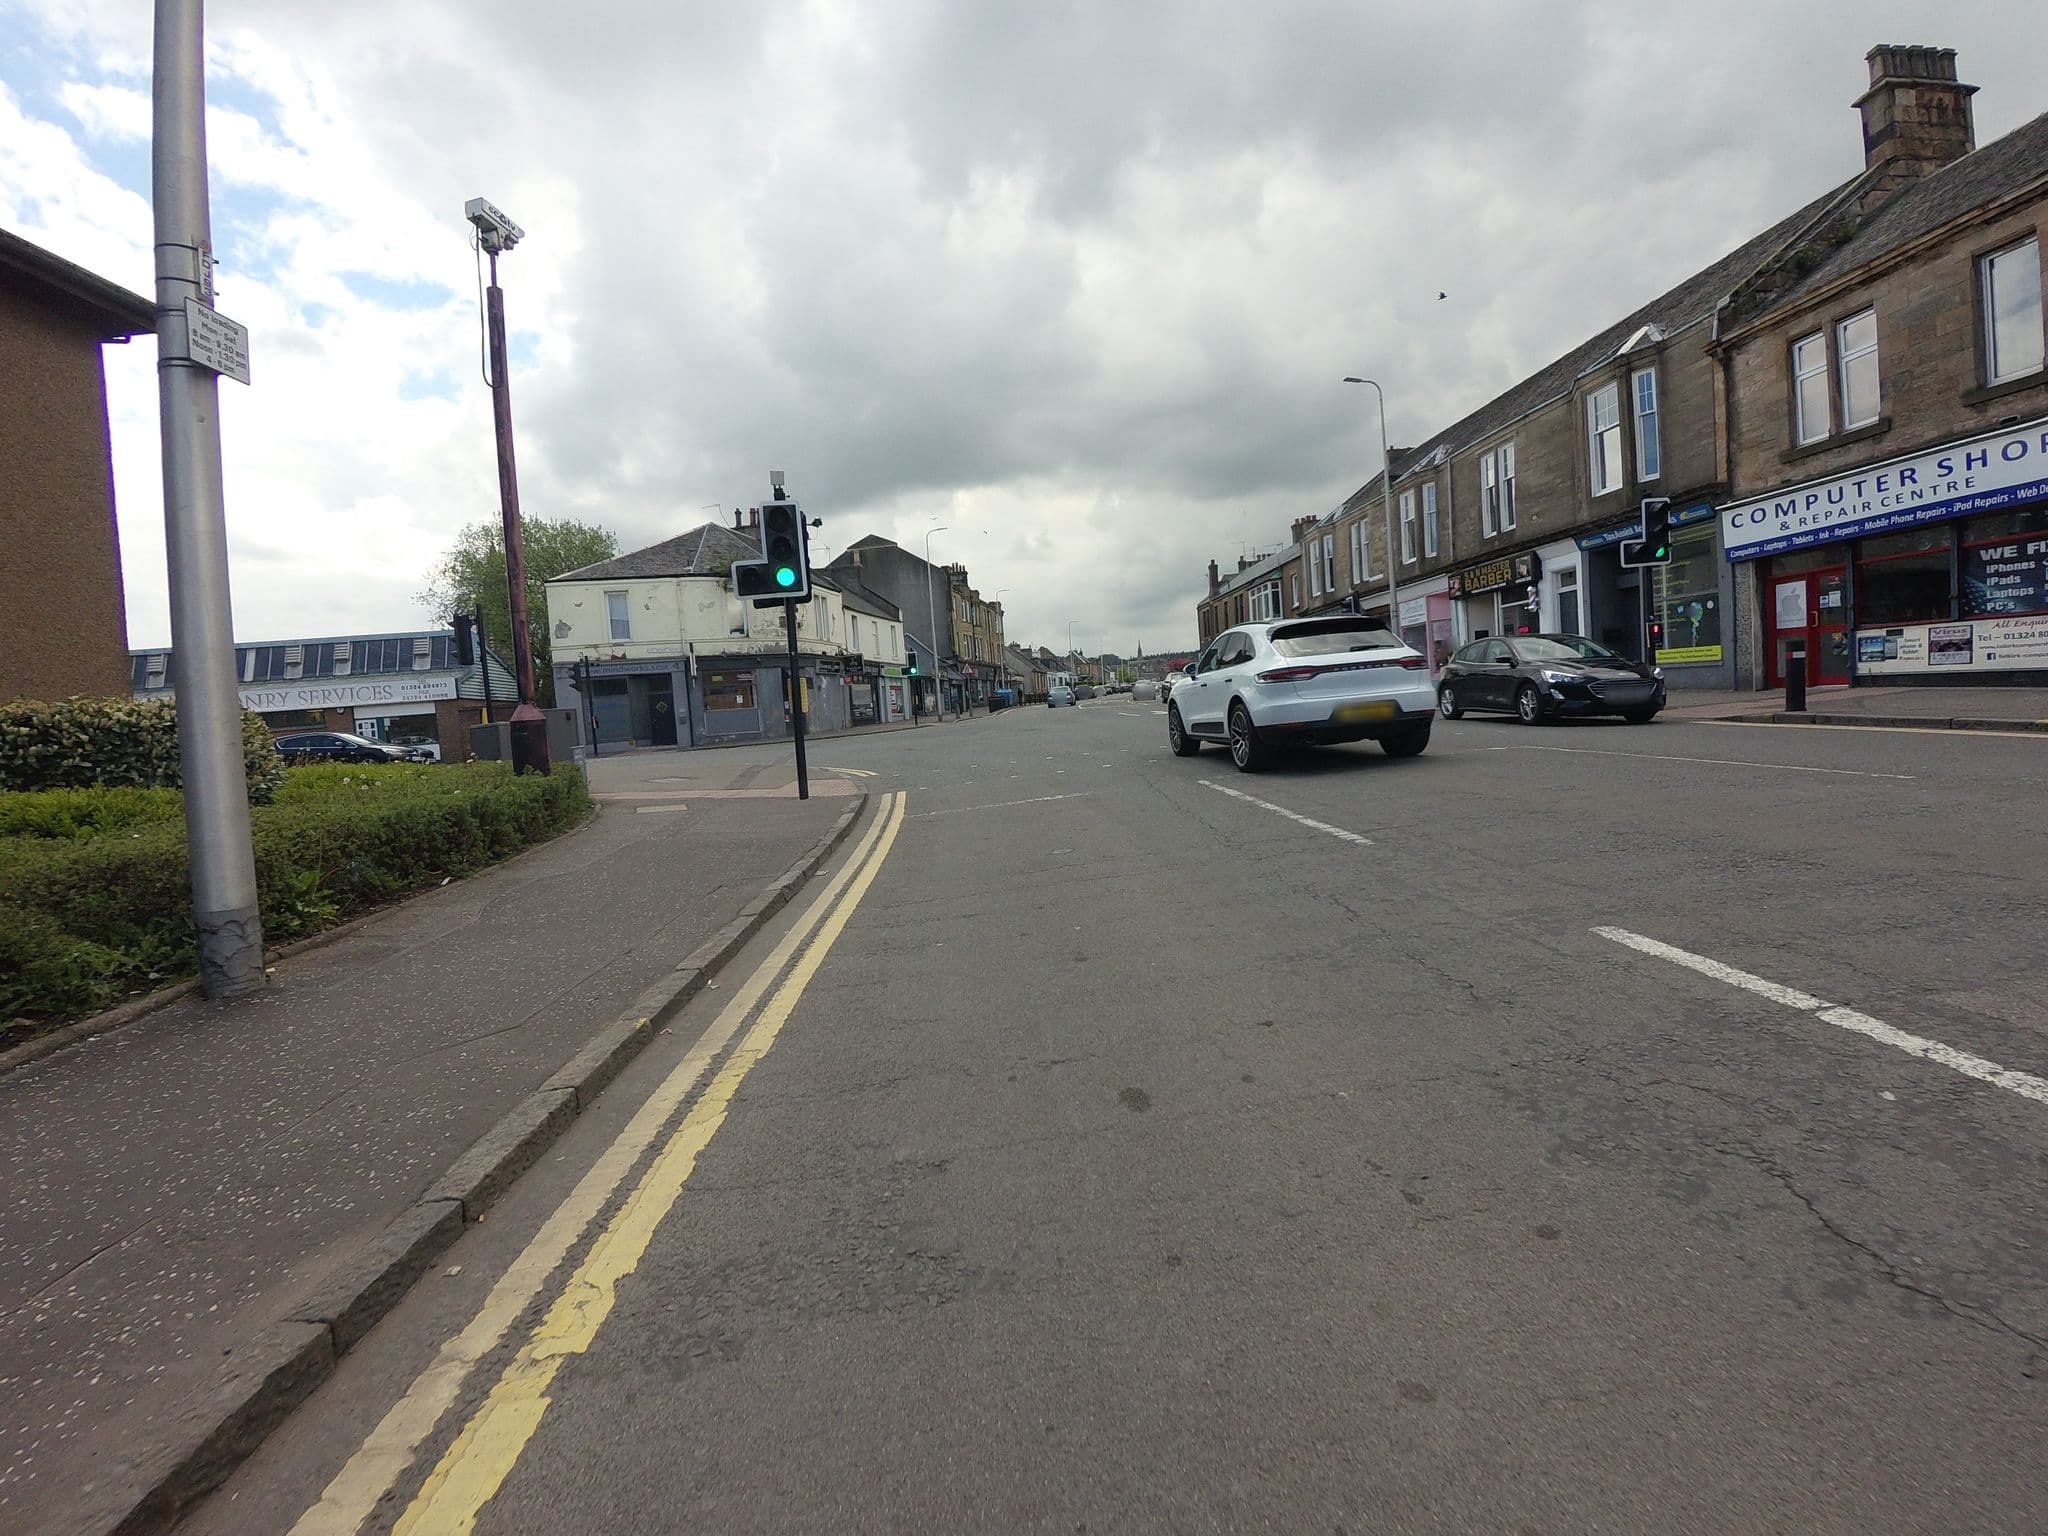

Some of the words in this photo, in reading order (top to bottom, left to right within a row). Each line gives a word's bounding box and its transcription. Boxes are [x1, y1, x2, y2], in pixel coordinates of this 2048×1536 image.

[211, 314, 239, 336] loading
[1731, 467, 1918, 529] COMPUTER
[1779, 520, 1791, 531] &
[1799, 502, 1872, 527] REPAIR
[1881, 476, 1976, 508] CENTRE
[1730, 546, 1760, 558] Computers
[1764, 541, 1788, 552] Laptops
[1792, 535, 1815, 545] Tablets
[1819, 531, 1830, 540] Ink
[1834, 525, 1860, 537] Repairs
[1864, 517, 1889, 531] Mobile
[1890, 513, 1915, 525] Phone
[1916, 507, 1947, 521] Repairs
[1953, 499, 1973, 513] iPad
[1974, 493, 2009, 508] Repairs
[2016, 486, 2038, 499] Web
[1980, 545, 2018, 560] WE
[2027, 540, 2048, 555] FI
[1464, 568, 1512, 592] BARBER
[1986, 587, 2034, 599] Laptops
[1986, 601, 2015, 611] PC's
[2004, 631, 2036, 640] 01324
[243, 692, 291, 709] NRY
[298, 685, 393, 706] SERVICES
